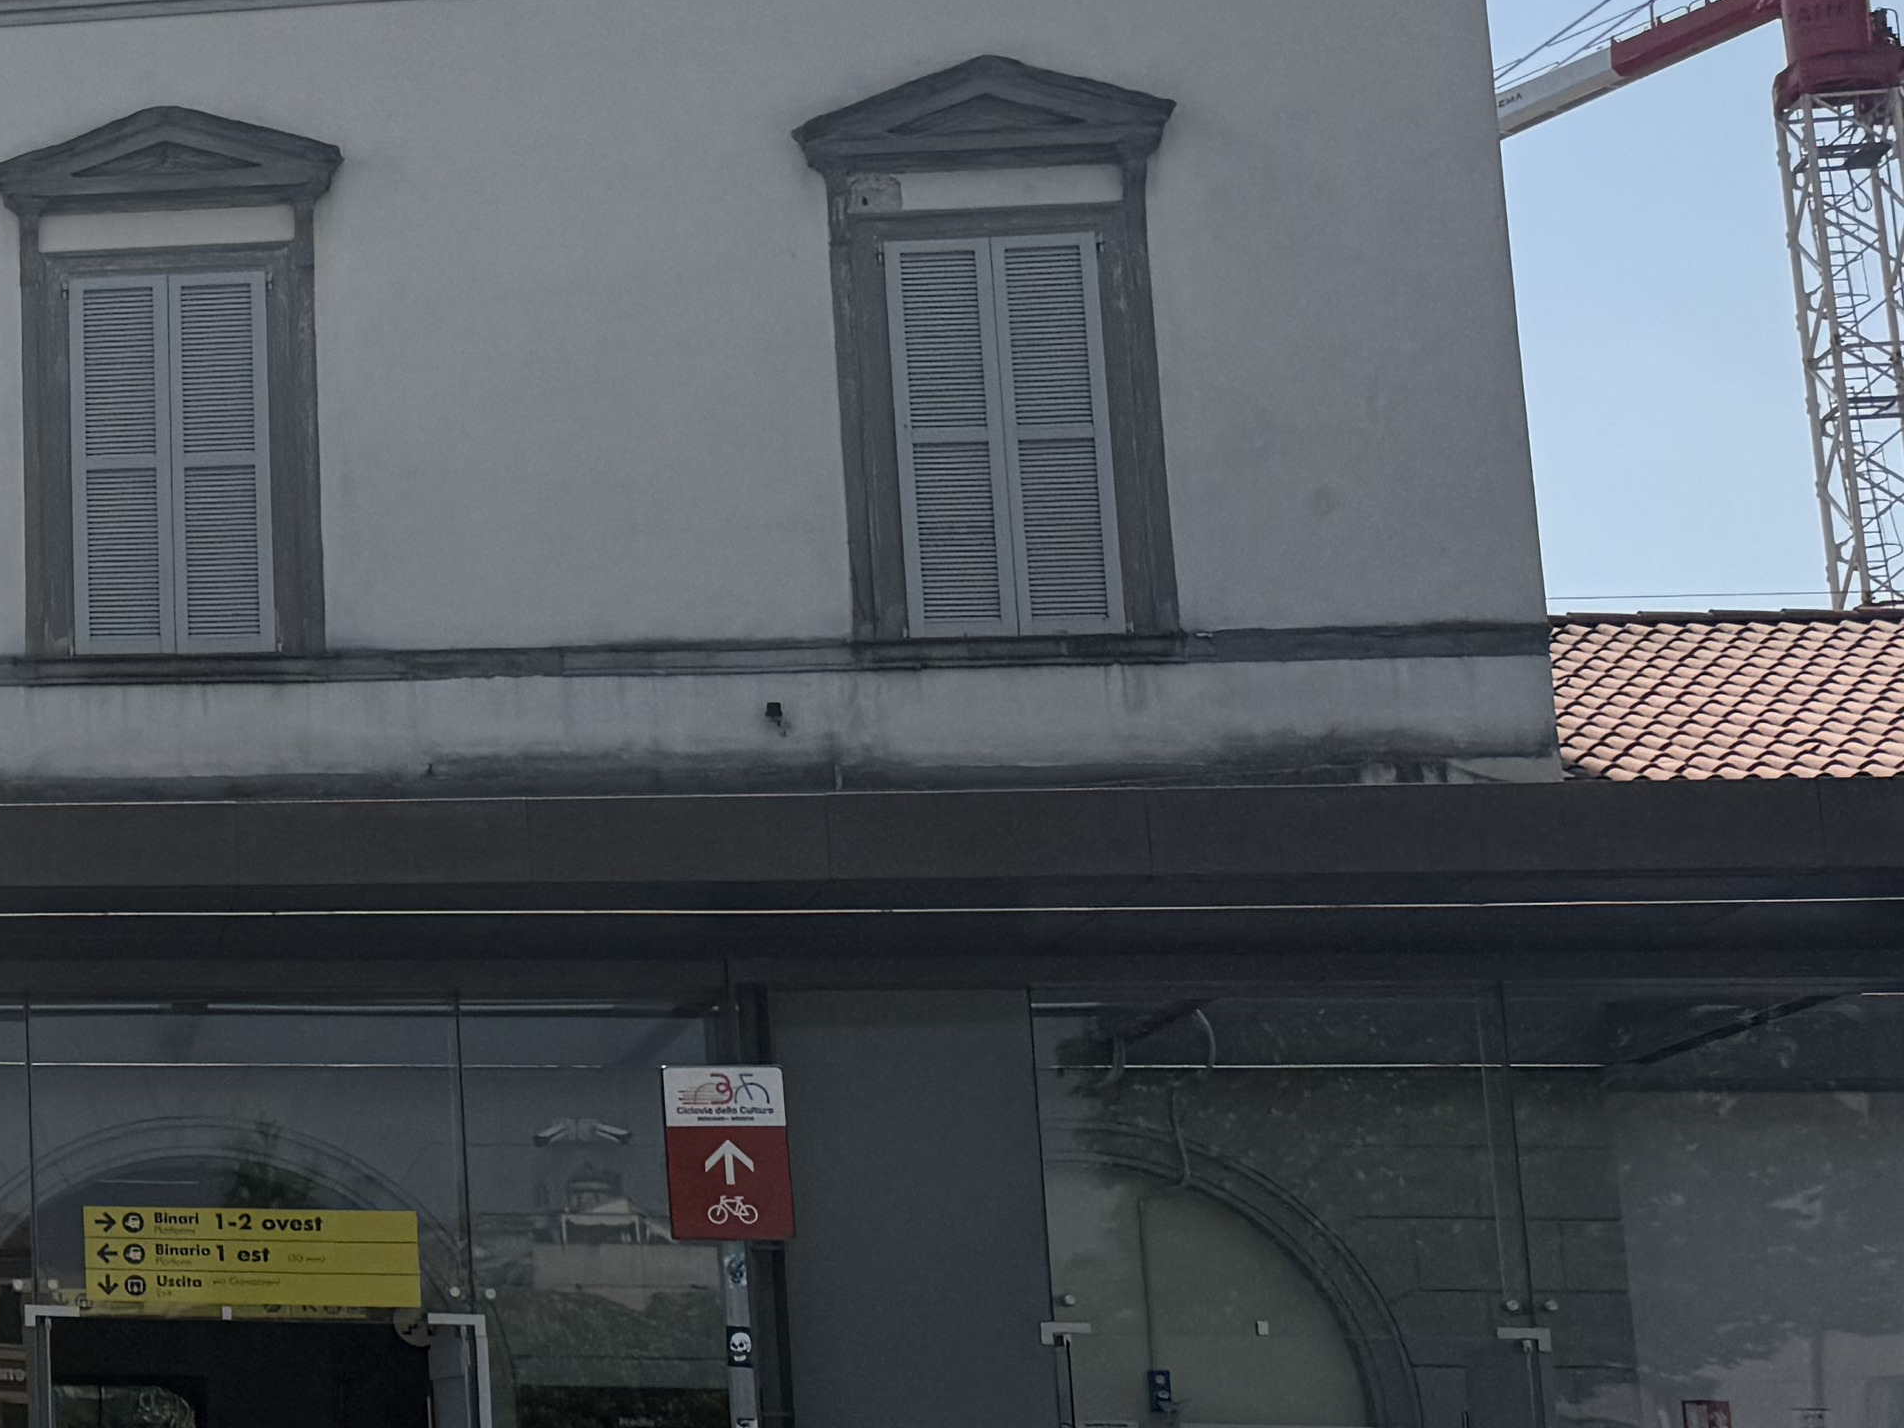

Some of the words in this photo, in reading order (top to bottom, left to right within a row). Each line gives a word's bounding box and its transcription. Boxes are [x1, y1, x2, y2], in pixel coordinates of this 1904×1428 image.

[154, 1212, 199, 1225] Binari
[215, 1213, 252, 1230] 1-2
[261, 1216, 323, 1232] ovest
[155, 1244, 211, 1256] Binario
[215, 1245, 225, 1262] 1
[237, 1247, 270, 1263] est
[156, 1275, 203, 1288] Uscita
